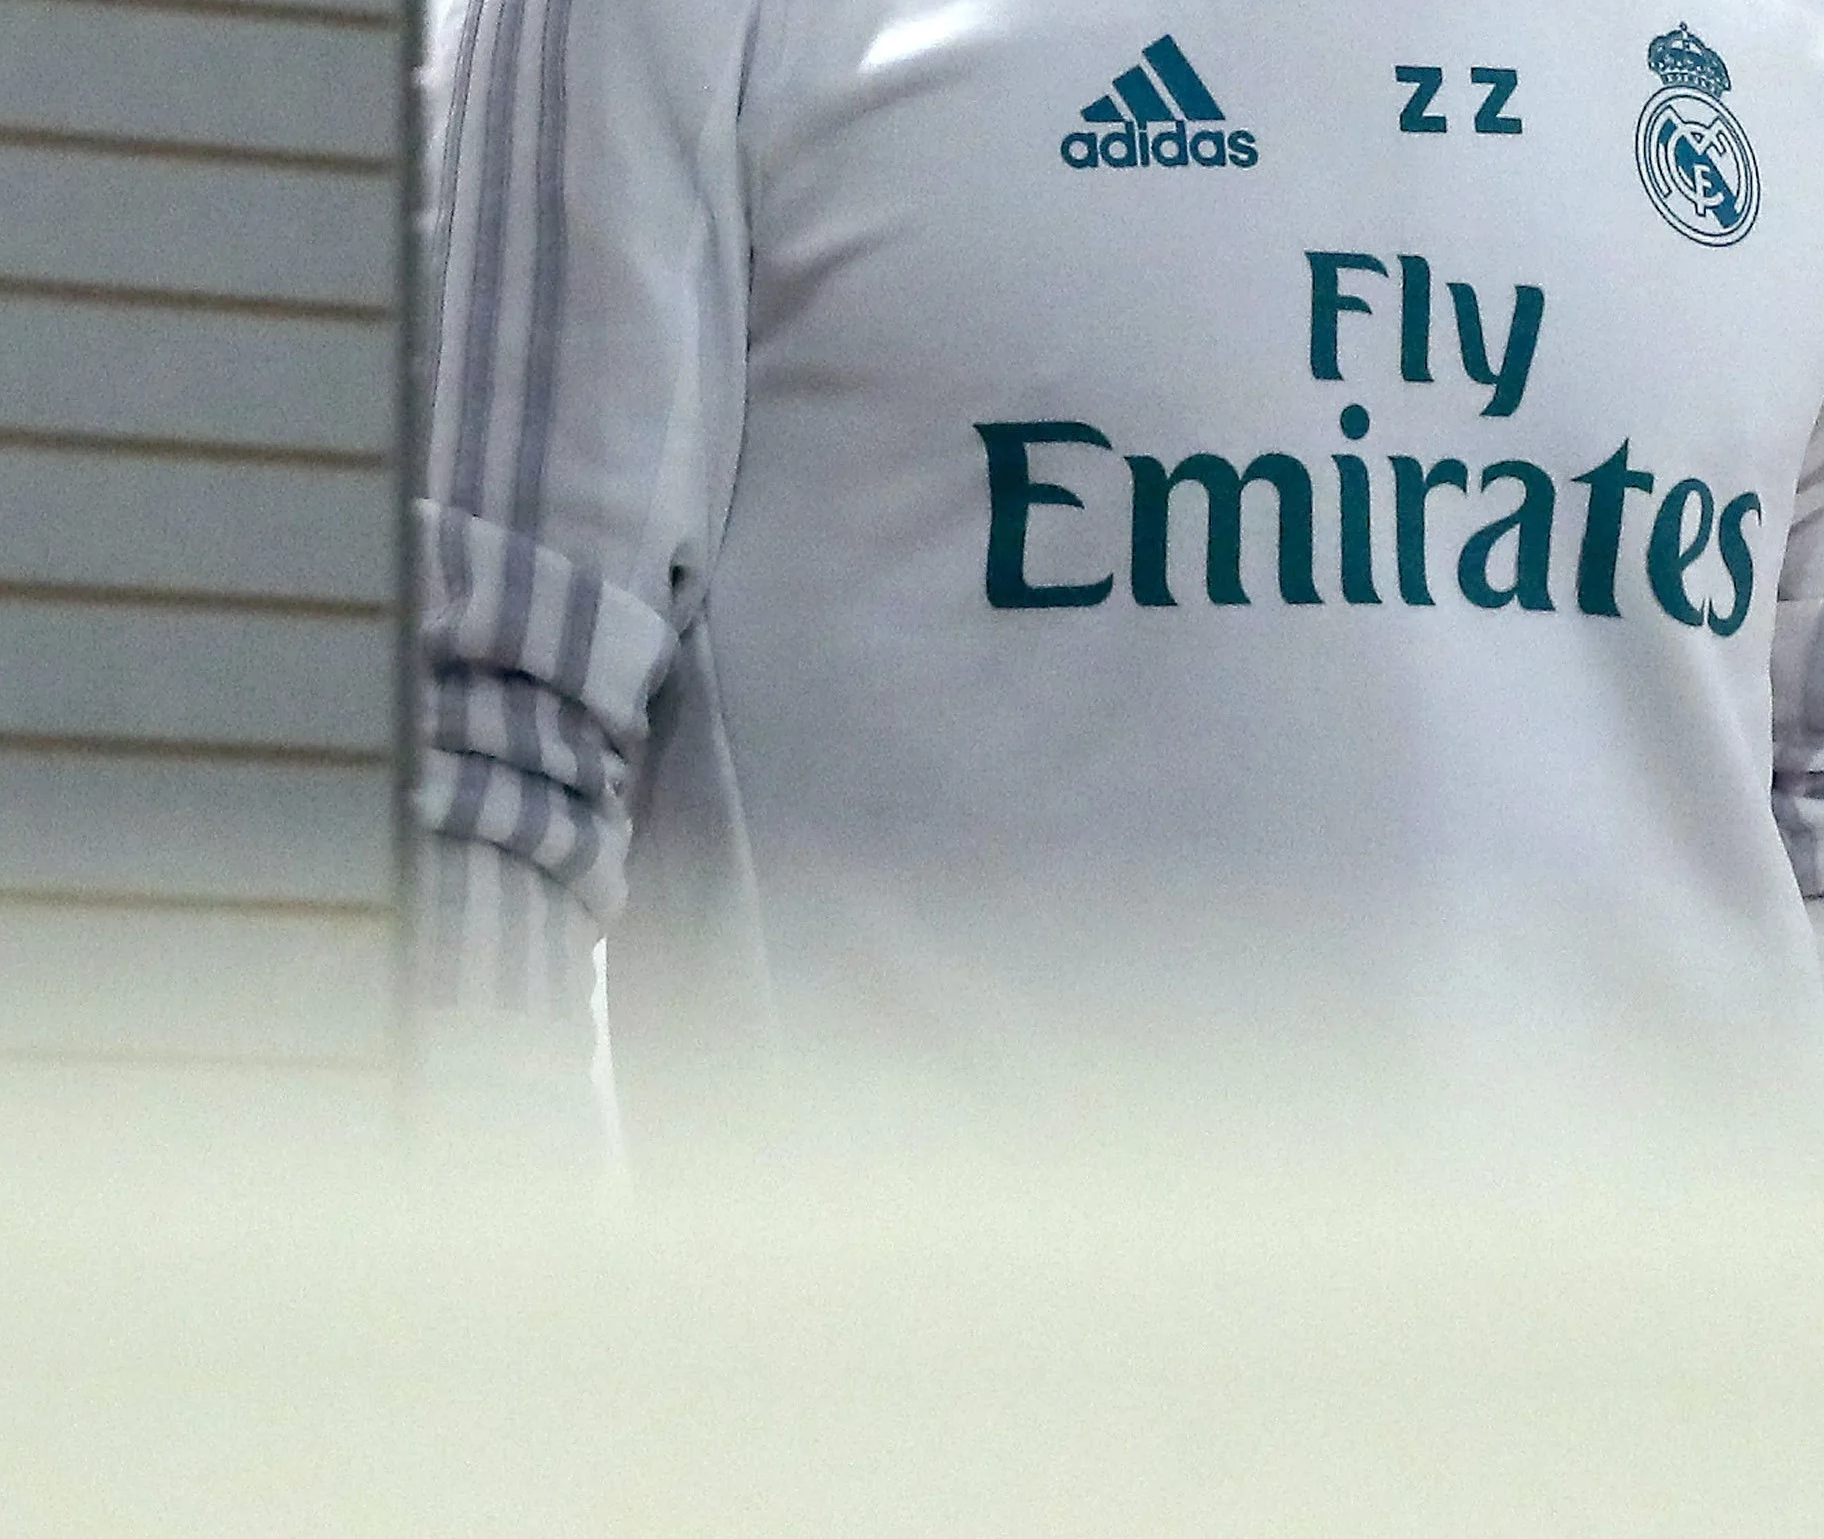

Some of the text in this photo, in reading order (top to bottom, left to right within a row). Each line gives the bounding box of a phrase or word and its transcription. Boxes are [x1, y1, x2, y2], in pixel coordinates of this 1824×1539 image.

[1060, 120, 1258, 169] adidas
[1303, 250, 1546, 417] Fly
[972, 404, 1762, 638] Emirates
